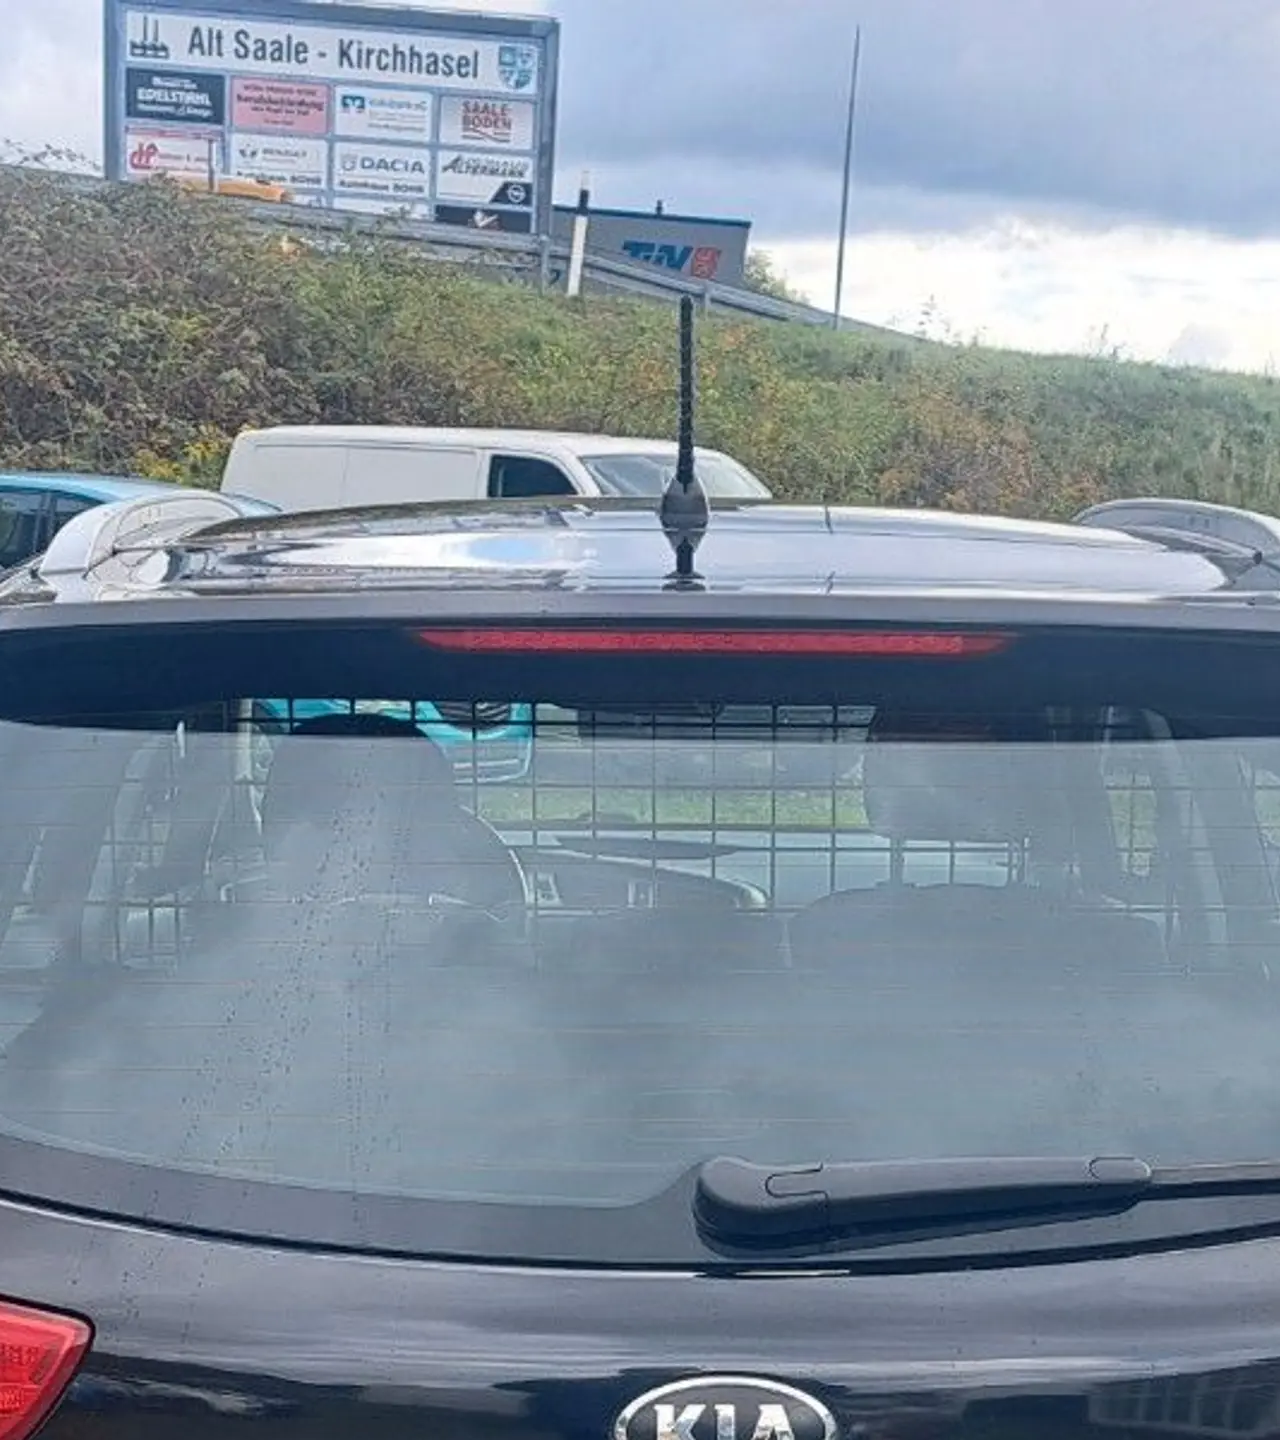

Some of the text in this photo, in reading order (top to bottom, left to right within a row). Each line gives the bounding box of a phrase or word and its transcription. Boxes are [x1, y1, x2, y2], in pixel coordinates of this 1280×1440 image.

[188, 26, 225, 58] Alt
[233, 28, 309, 65] Saale
[337, 38, 479, 79] Kirchhasel
[360, 156, 425, 175] DACIA
